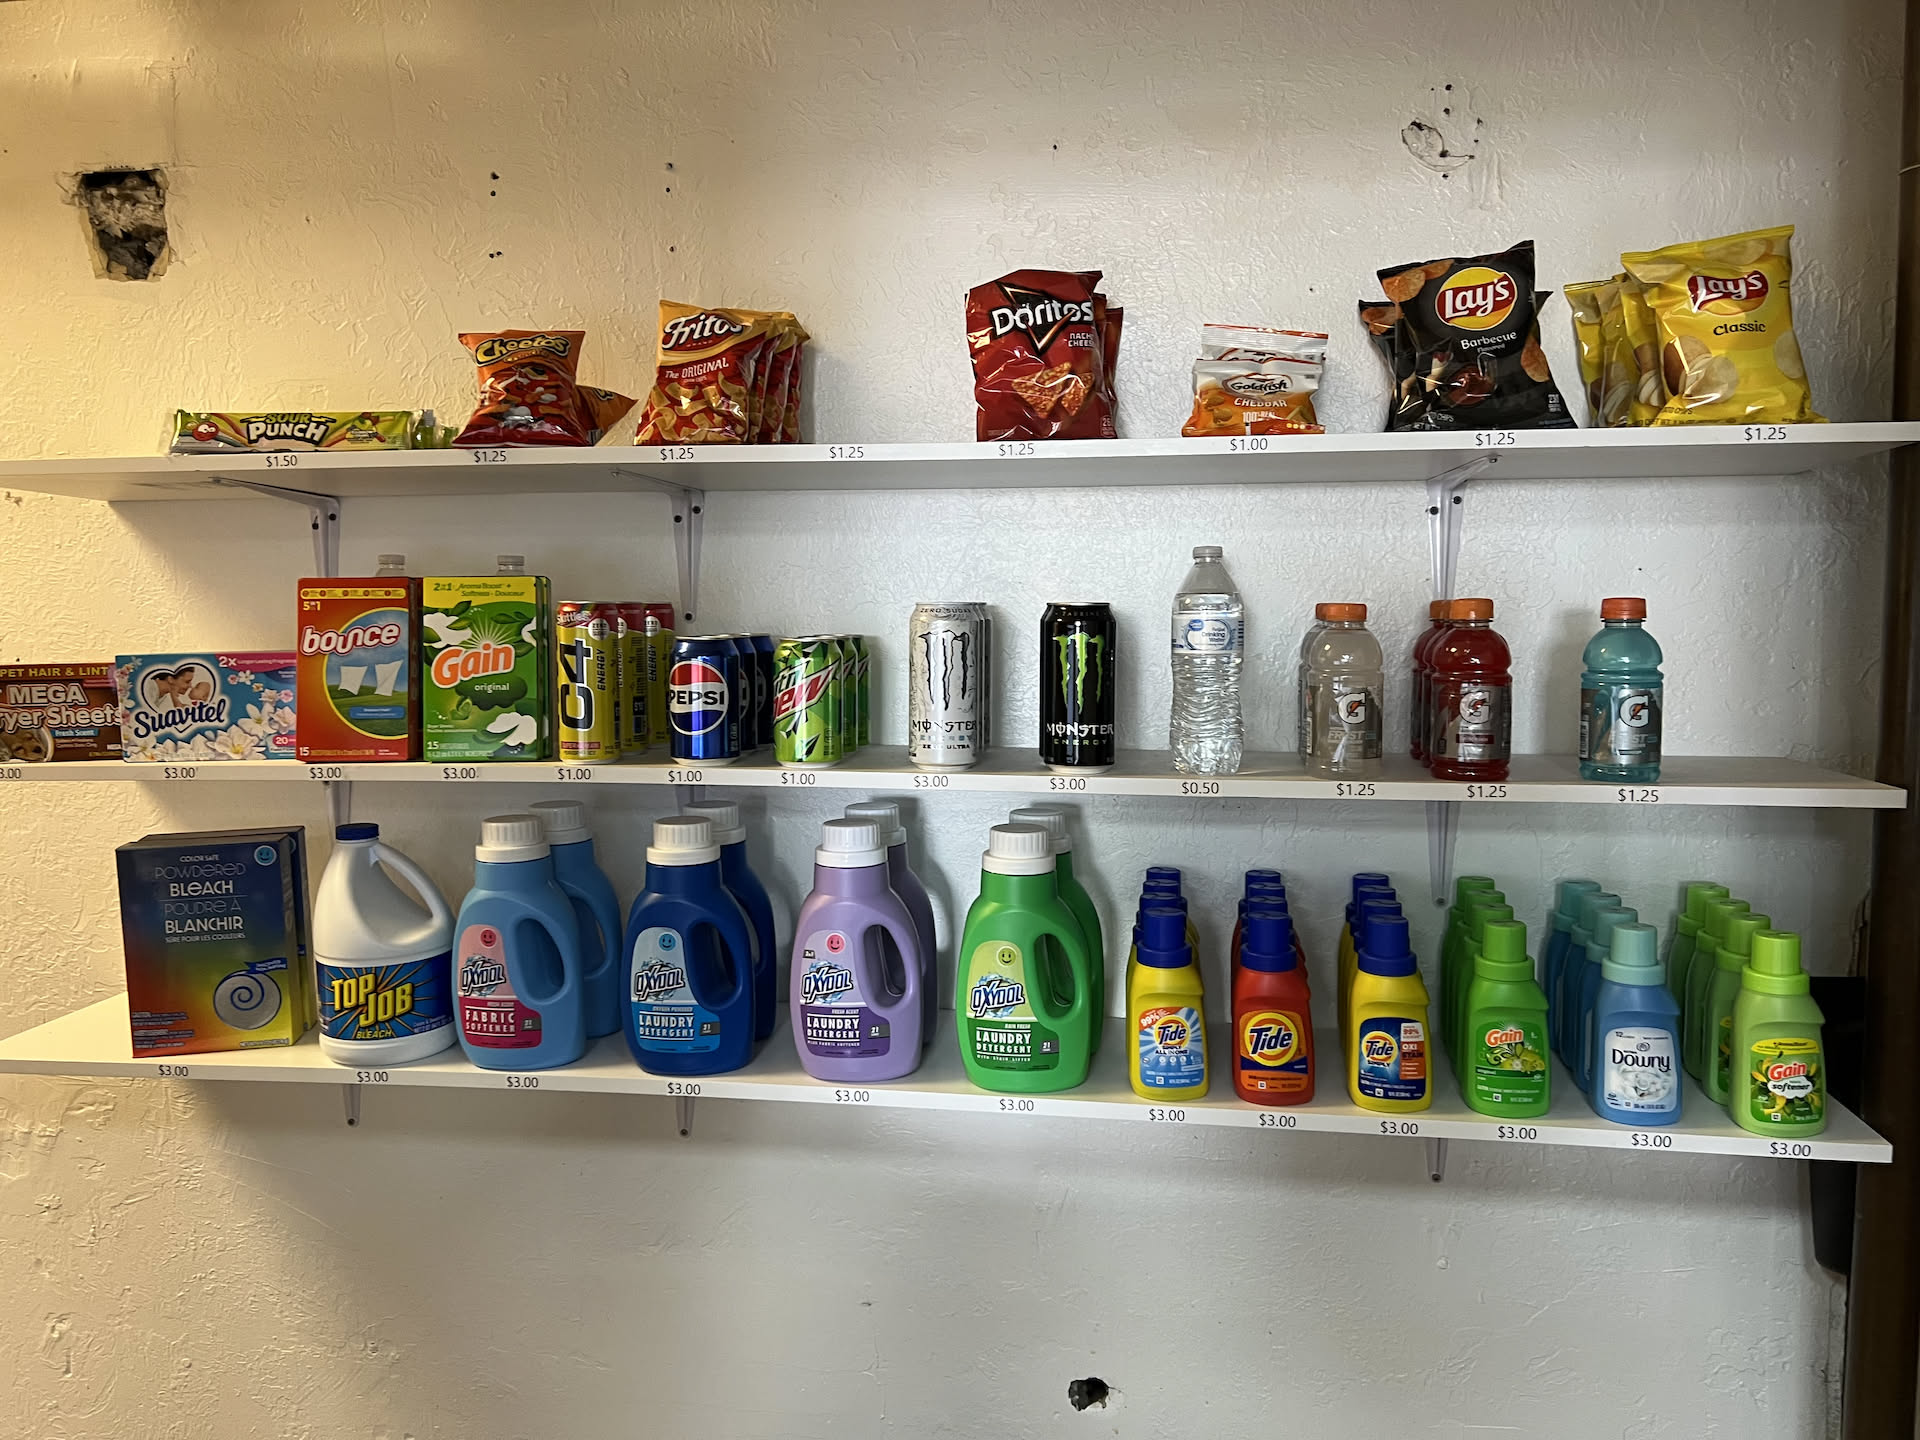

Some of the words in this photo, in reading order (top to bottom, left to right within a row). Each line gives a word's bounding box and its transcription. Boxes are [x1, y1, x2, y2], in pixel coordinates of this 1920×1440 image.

[1444, 278, 1510, 318] Lay's
[1692, 271, 1762, 313] Lay's
[991, 300, 1094, 336] Doritos
[1712, 319, 1766, 336] Classic
[1460, 331, 1518, 350] Barbecue
[476, 335, 570, 366] Cheetos
[665, 370, 679, 379] The
[681, 357, 729, 378] ORIGINAL
[1231, 379, 1289, 396] Goldfish
[1234, 397, 1288, 407] CHEDDAR
[264, 412, 311, 424] SOUR
[249, 421, 329, 445] PUNCH
[1475, 432, 1515, 446] $1.25
[1744, 427, 1787, 441] $1.25
[998, 443, 1035, 456] $1.25
[1230, 438, 1268, 451] $1.00
[473, 450, 507, 463] $1.25
[660, 448, 695, 461] $1.25
[829, 446, 865, 459] $1.25
[266, 455, 298, 468] $1.50
[303, 623, 400, 653] bounce
[433, 642, 513, 687] Gain
[597, 648, 607, 691] ENERGY
[648, 644, 657, 682] ENERGY
[0, 667, 25, 678] PET
[33, 667, 63, 678] HAIR
[65, 667, 74, 677] &
[78, 665, 109, 677] LINT
[474, 682, 510, 693] original
[559, 638, 595, 730] C4
[10, 684, 87, 706] MEGA
[669, 690, 725, 706] PEPSI
[1338, 693, 1366, 724] G
[1459, 691, 1491, 725] G
[1620, 695, 1649, 728] G
[49, 705, 121, 726] Sheets
[134, 698, 226, 739] Suavitel
[913, 719, 977, 733] MONSTER
[1046, 721, 1114, 738] MONSTER
[276, 737, 289, 745] 20
[427, 741, 439, 750] 15
[1054, 738, 1107, 746] ENERGY
[299, 747, 310, 755] 15
[164, 768, 195, 779] $3.00
[310, 768, 342, 779] $3.00
[443, 768, 476, 779] $3.00
[558, 769, 591, 781] $1.00
[668, 770, 702, 783] $1.00
[781, 772, 816, 785] $1.00
[914, 775, 949, 788] $3.00
[1050, 777, 1086, 790] $3.00
[1182, 781, 1220, 795] $0.50
[1336, 783, 1375, 796] $1.25
[1467, 785, 1507, 798] $1.25
[1618, 788, 1659, 803] $1.25
[164, 915, 244, 934] BLANCHIR
[331, 973, 376, 1011] TOP
[358, 982, 414, 1028] JOB
[465, 1010, 515, 1023] FABRIC
[639, 1015, 694, 1028] LAUNDRY
[807, 1016, 860, 1029] LAUNDRY
[1141, 1014, 1159, 1027] 99%
[356, 1030, 392, 1040] BLEACH
[465, 1023, 516, 1033] SOFTENER
[639, 1028, 694, 1038] DETERGENT
[807, 1029, 860, 1038] DETERGENT
[1157, 1023, 1187, 1045] Tide
[976, 1031, 1031, 1044] LAUNDRY
[1249, 1026, 1292, 1056] Tide
[1485, 1029, 1525, 1046] Gain
[976, 1043, 1031, 1053] DETERGENT
[1366, 1039, 1394, 1058] Tide
[1612, 1048, 1671, 1072] Downy
[158, 1065, 189, 1077] $3.00
[357, 1071, 389, 1083] $3.00
[1768, 1063, 1807, 1081] Gain
[507, 1076, 539, 1088] $3.00
[667, 1082, 701, 1095] $3.00
[1771, 1082, 1811, 1093] softener
[835, 1089, 869, 1102] $3.00
[999, 1099, 1034, 1112] $3.00
[1149, 1108, 1185, 1122] $3.00
[1259, 1113, 1296, 1127] $3.00
[1380, 1121, 1419, 1135] $3.00
[1498, 1126, 1537, 1140] $3.00
[1631, 1133, 1672, 1148] $3.00
[1770, 1142, 1812, 1157] $3.00
